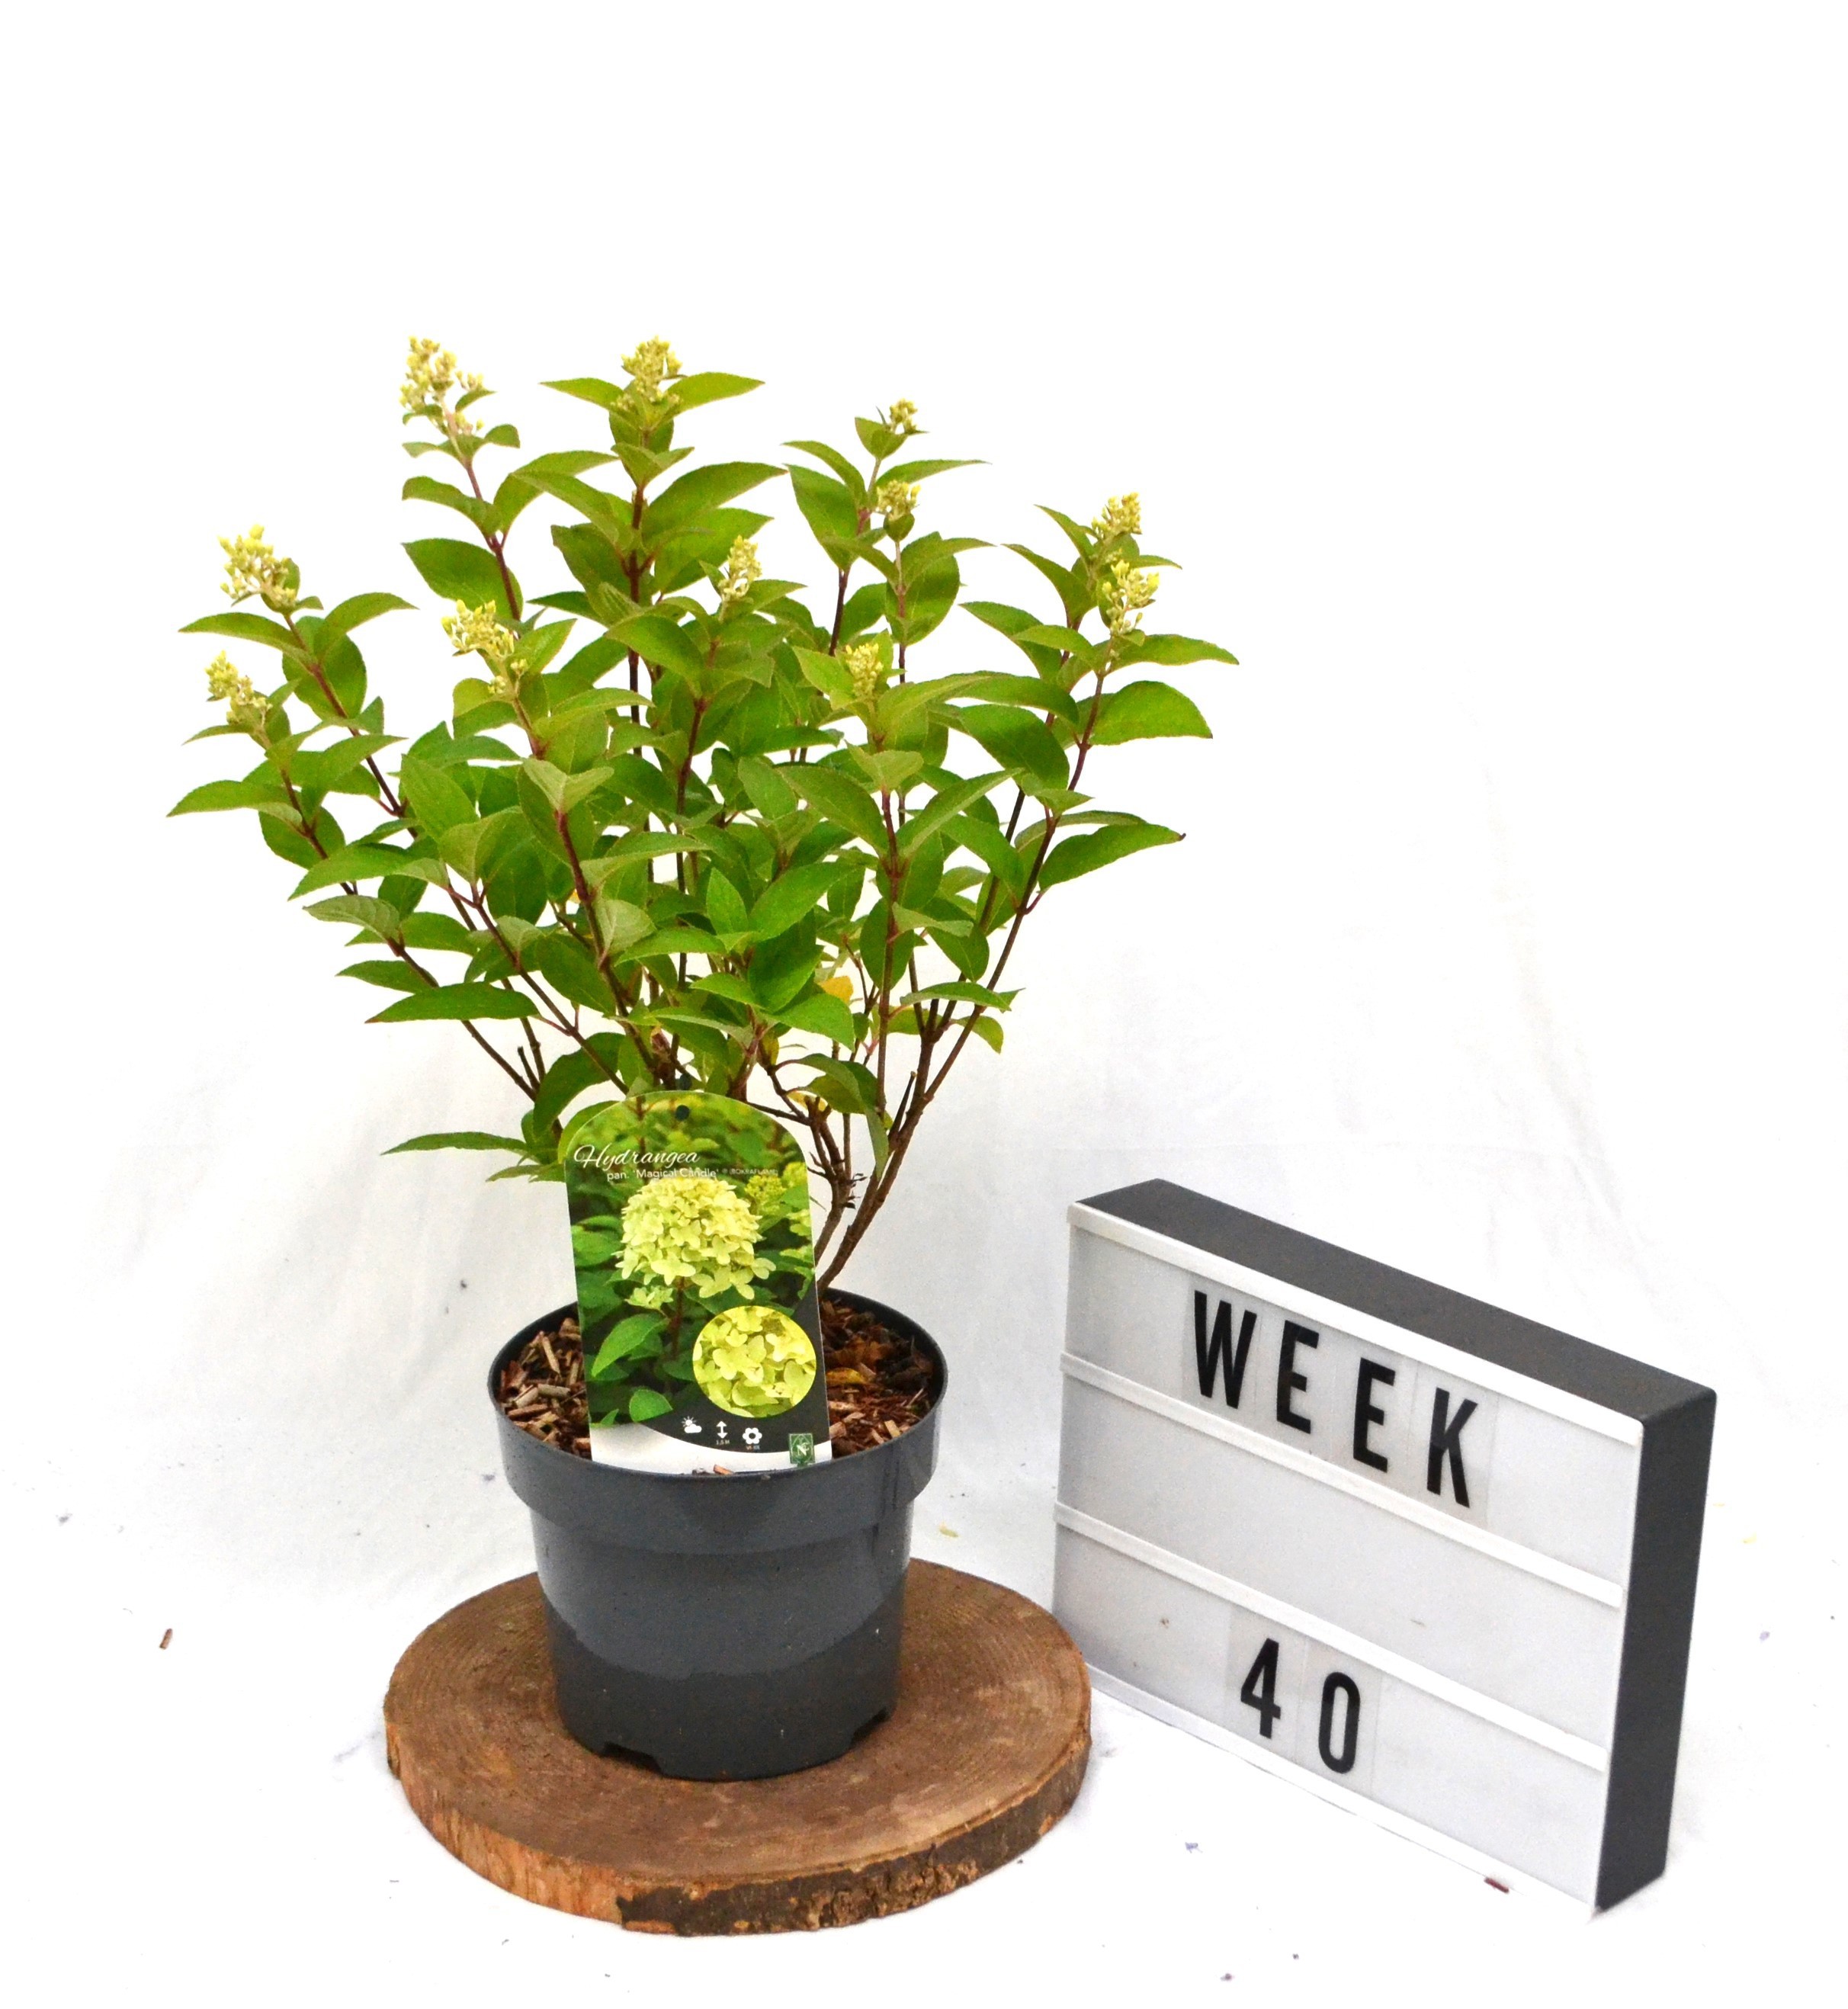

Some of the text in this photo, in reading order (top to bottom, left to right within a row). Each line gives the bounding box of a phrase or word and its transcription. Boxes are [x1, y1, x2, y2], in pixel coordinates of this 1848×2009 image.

[574, 1143, 700, 1171] Hydrangea
[607, 1172, 630, 1182] pan.
[1194, 1290, 1477, 1508] WEEK
[1240, 1638, 1361, 1773] 40
